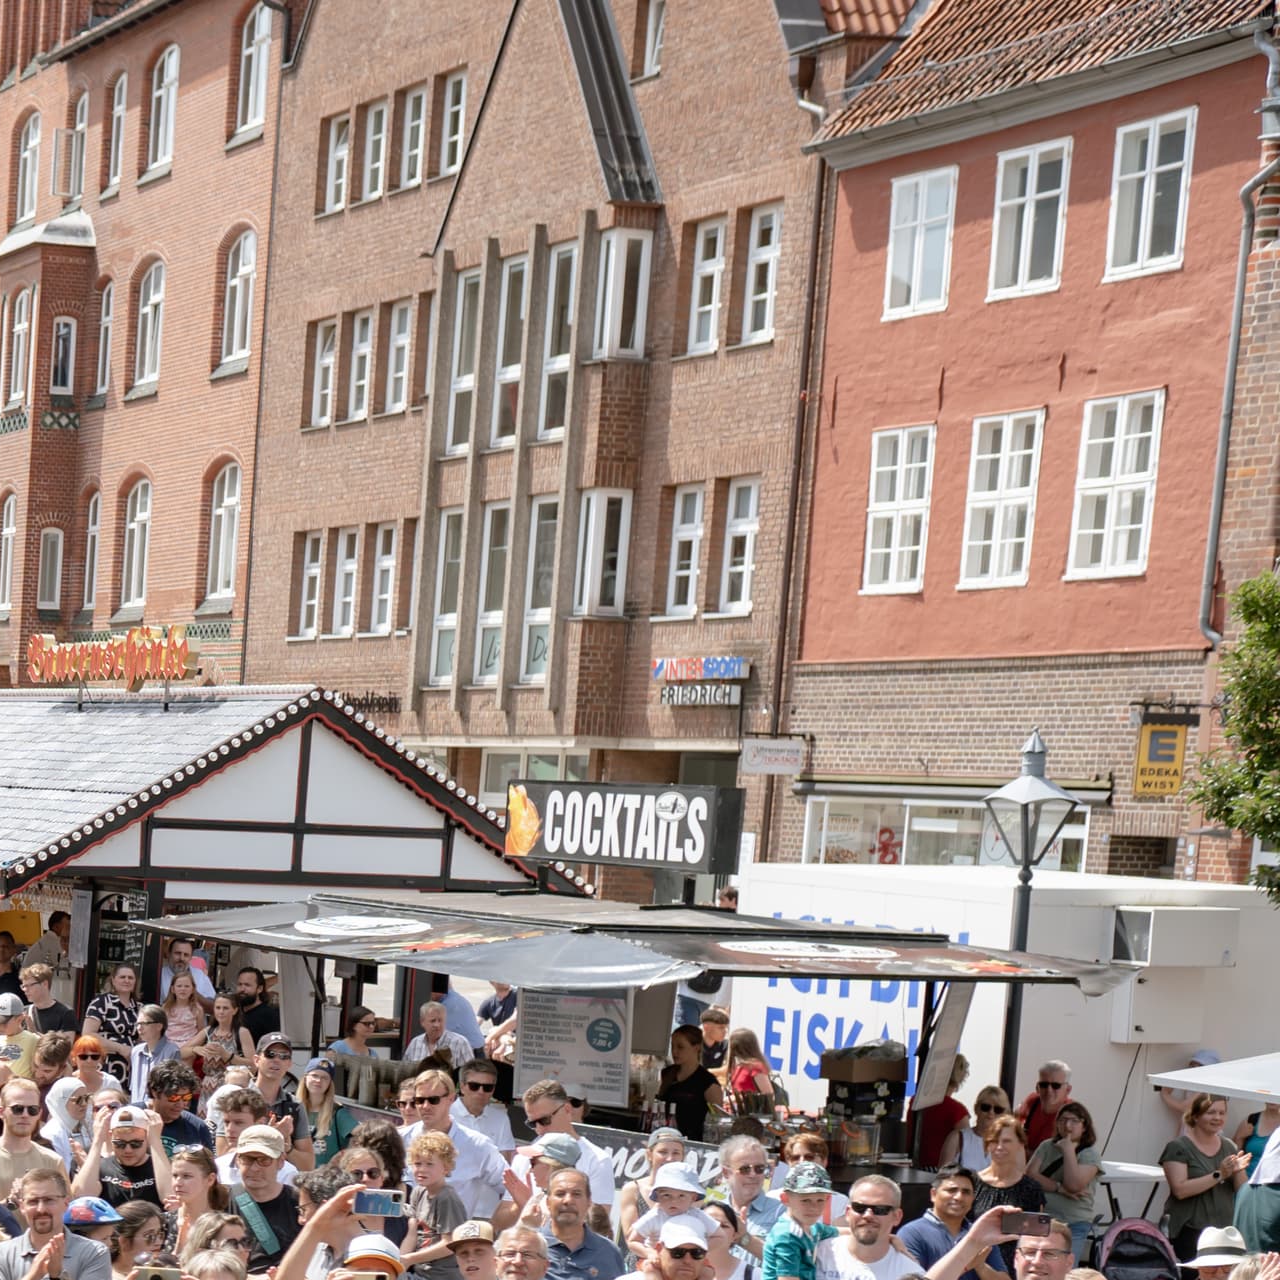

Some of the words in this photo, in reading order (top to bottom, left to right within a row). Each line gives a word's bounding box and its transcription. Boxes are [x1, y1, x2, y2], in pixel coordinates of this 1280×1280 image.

[664, 656, 744, 681] INTERSPORT
[660, 684, 732, 705] FRIEDRICH
[1148, 730, 1178, 762] E
[1140, 768, 1180, 777] EDEKA
[544, 789, 709, 865] COCKTAILS
